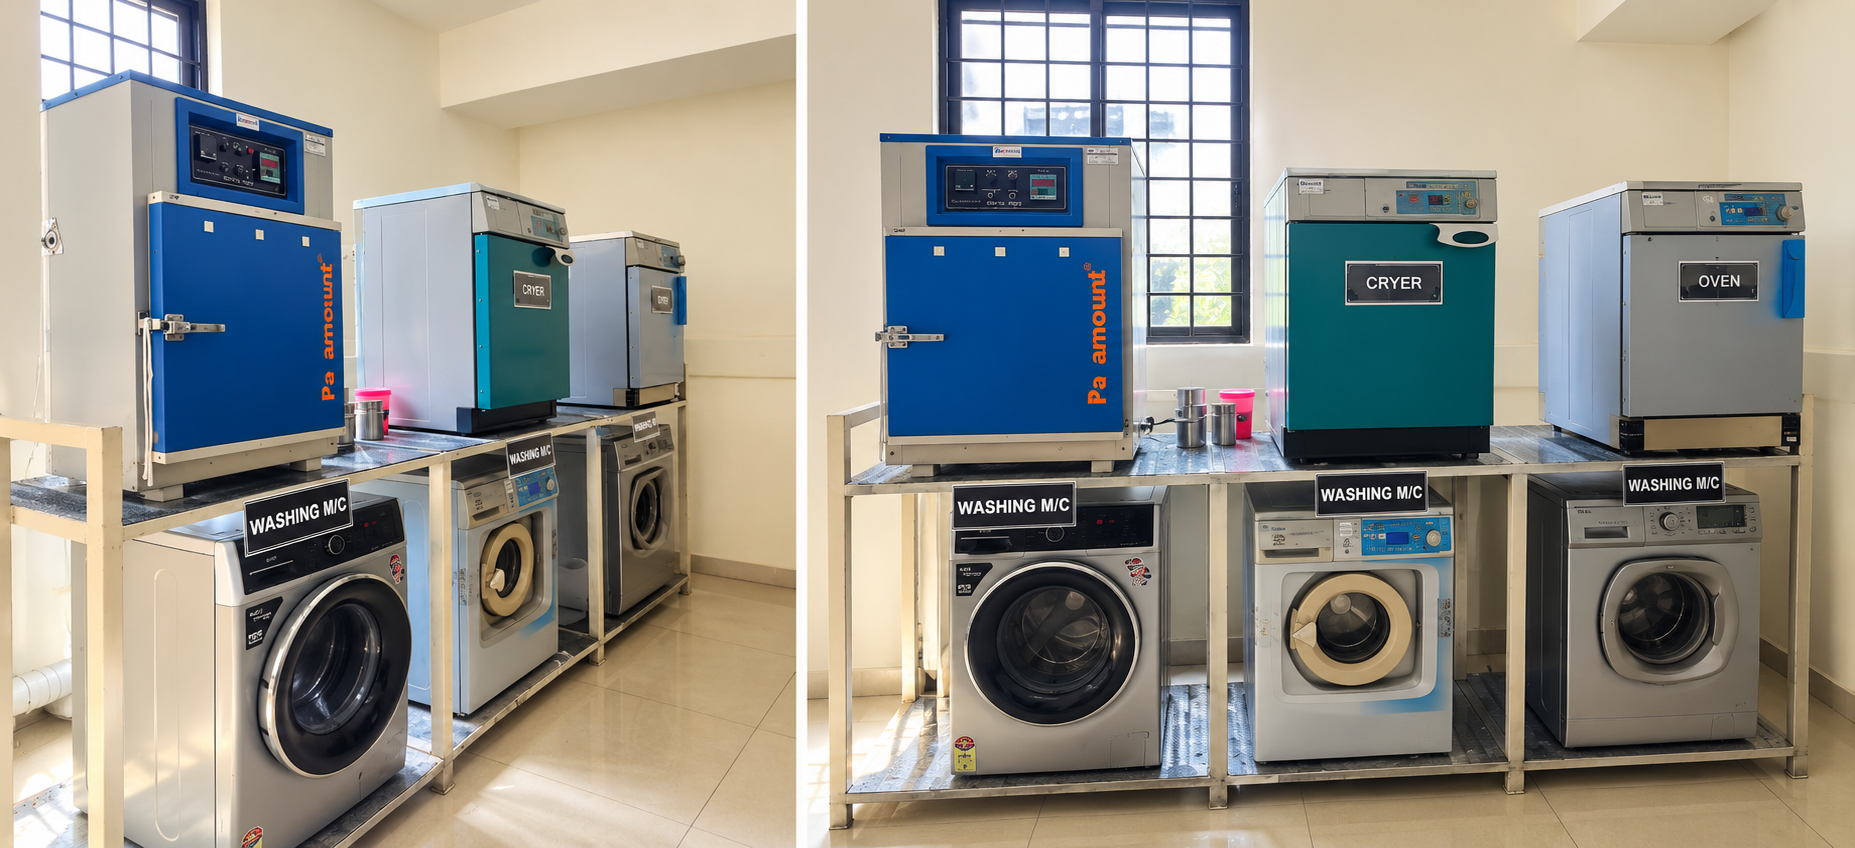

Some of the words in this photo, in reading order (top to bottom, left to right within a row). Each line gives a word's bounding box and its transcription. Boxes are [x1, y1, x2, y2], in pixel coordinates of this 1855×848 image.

[1366, 276, 1422, 290] CRYER
[1698, 274, 1741, 288] OVEN
[522, 284, 545, 297] CRYER
[509, 447, 540, 466] WASHING
[1627, 477, 1693, 492] WASHING
[1696, 476, 1720, 490] M/C
[1320, 486, 1392, 502] WASHING
[1396, 485, 1423, 500] M/C
[957, 499, 1036, 515] WASHING
[1041, 497, 1070, 513] M/C
[249, 503, 320, 536] WASHING
[323, 497, 347, 517] M/C
